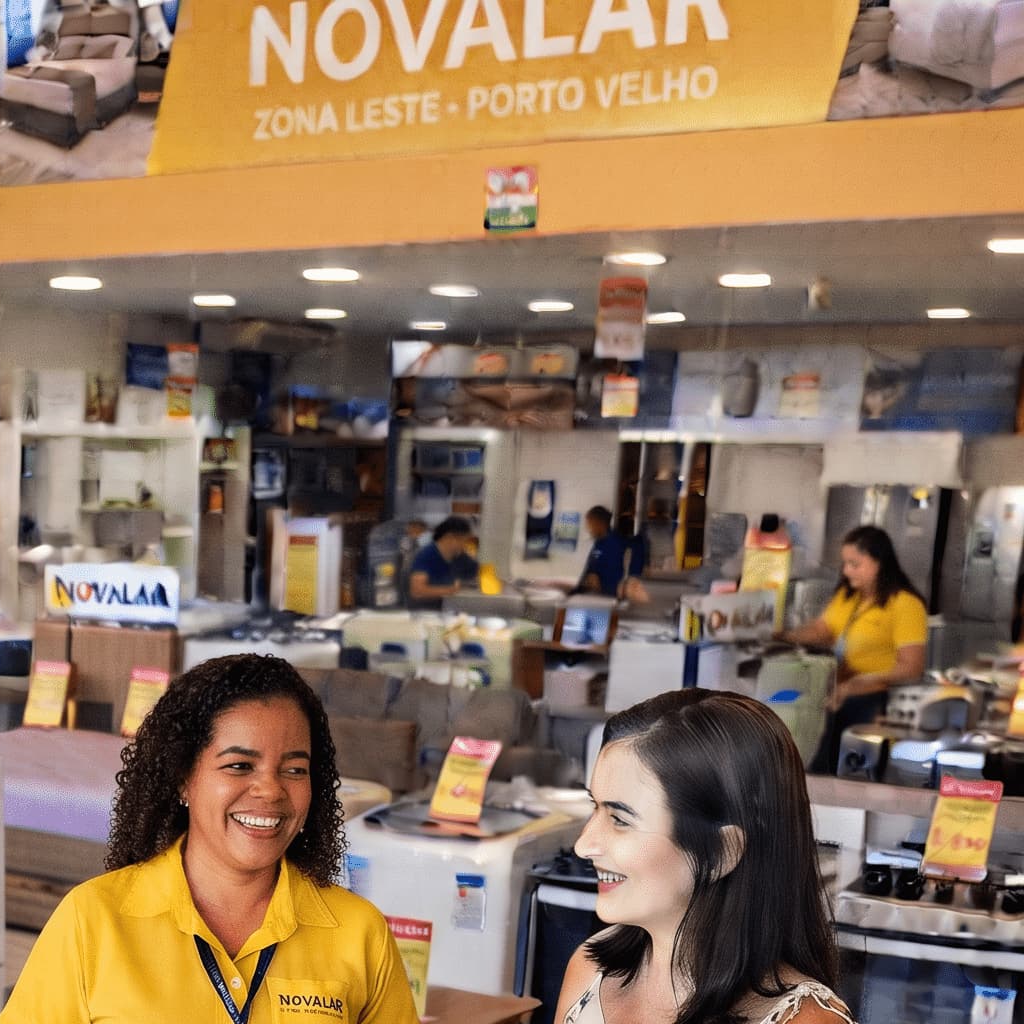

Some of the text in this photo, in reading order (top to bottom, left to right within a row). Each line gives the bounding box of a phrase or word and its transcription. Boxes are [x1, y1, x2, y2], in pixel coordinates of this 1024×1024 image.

[253, 65, 720, 141] ZONA LESTE PORTO VELHO
[278, 994, 343, 1014] NOVALAR
